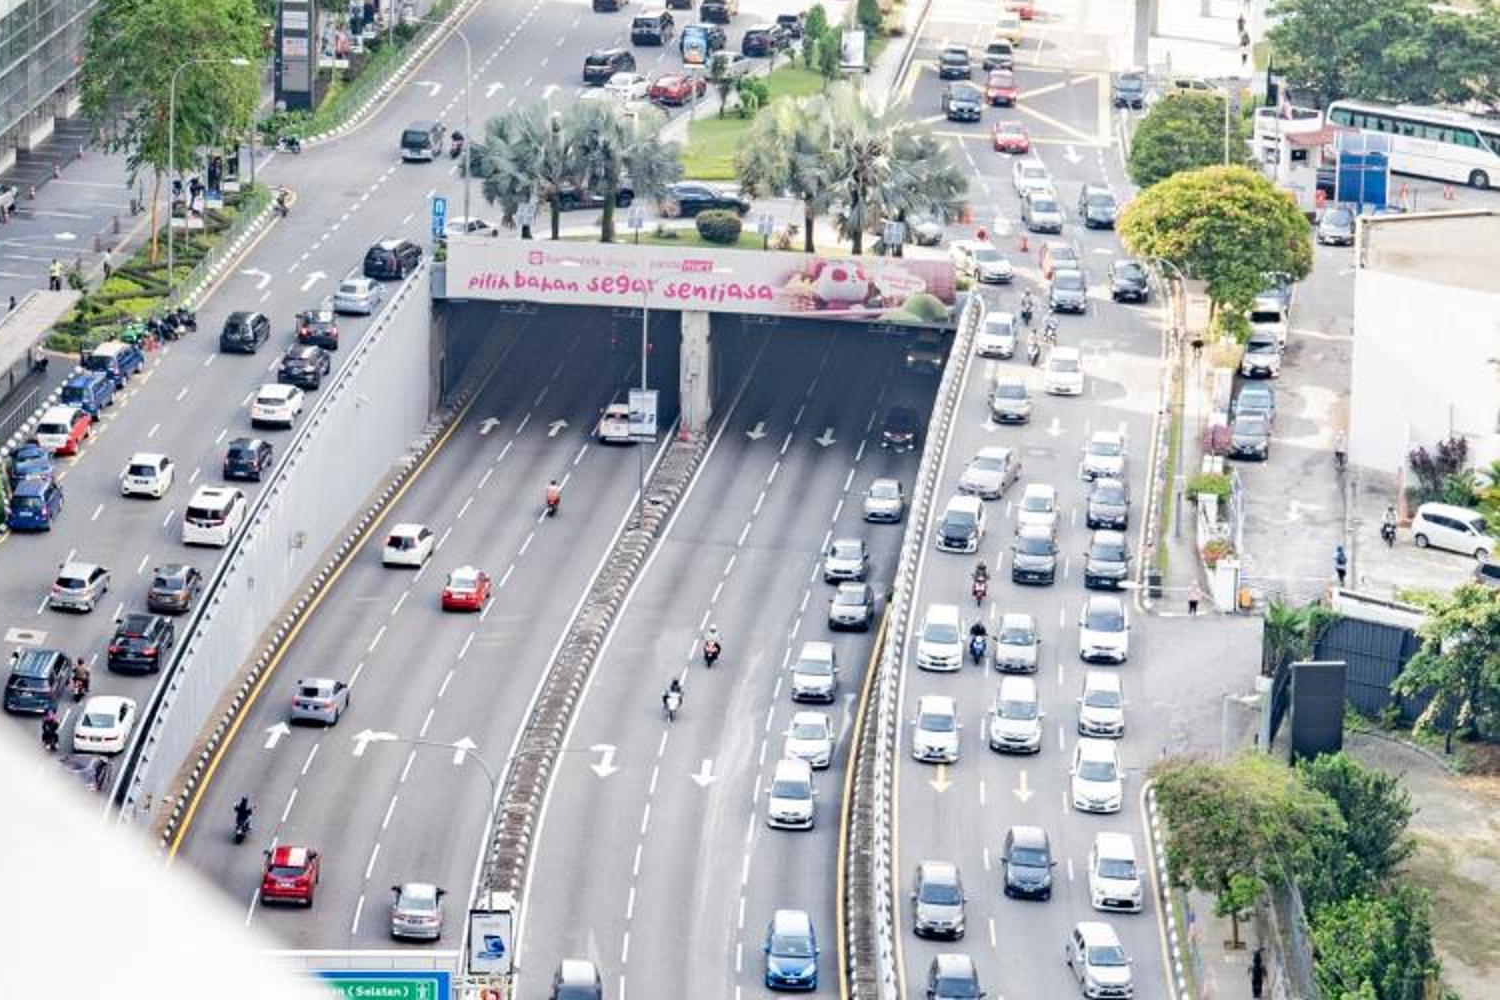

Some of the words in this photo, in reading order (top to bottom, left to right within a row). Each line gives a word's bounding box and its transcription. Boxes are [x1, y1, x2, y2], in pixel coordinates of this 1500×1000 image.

[468, 269, 509, 290] pilih
[514, 270, 580, 293] bahan
[587, 273, 655, 295] segar
